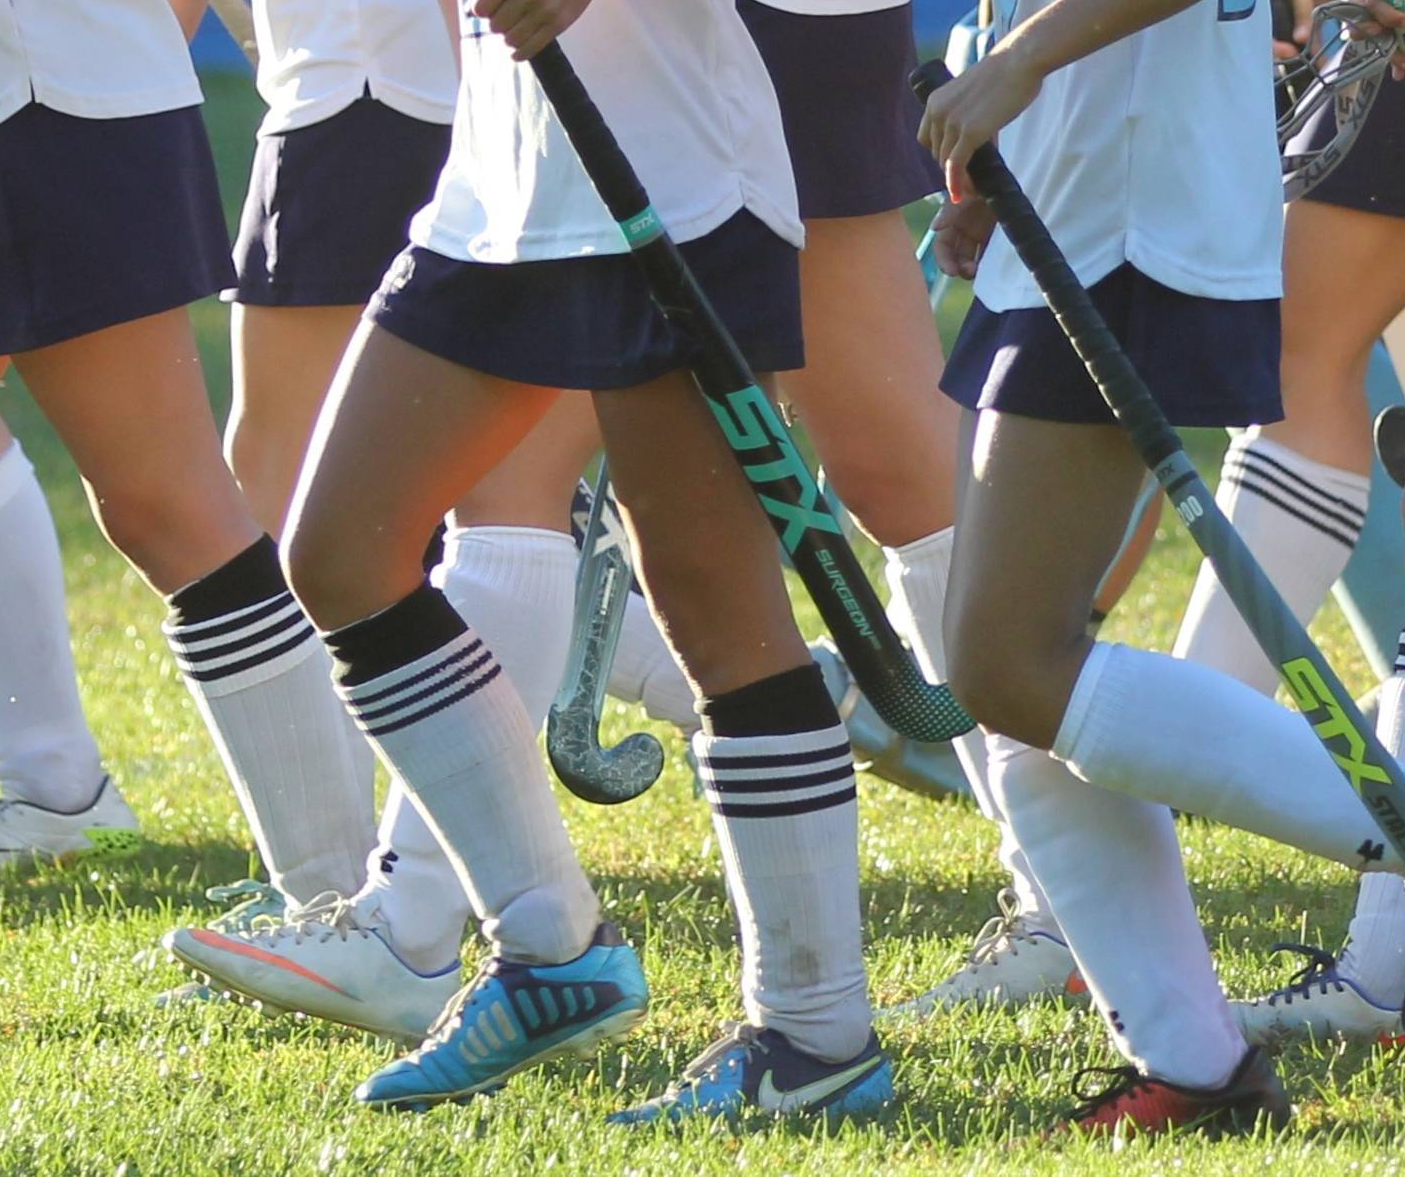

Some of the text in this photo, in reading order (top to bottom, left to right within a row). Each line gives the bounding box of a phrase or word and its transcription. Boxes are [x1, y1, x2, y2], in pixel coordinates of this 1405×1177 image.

[629, 212, 656, 235] STX
[707, 384, 844, 556] STX
[815, 549, 873, 637] SURGEON
[1281, 656, 1394, 797] STX
